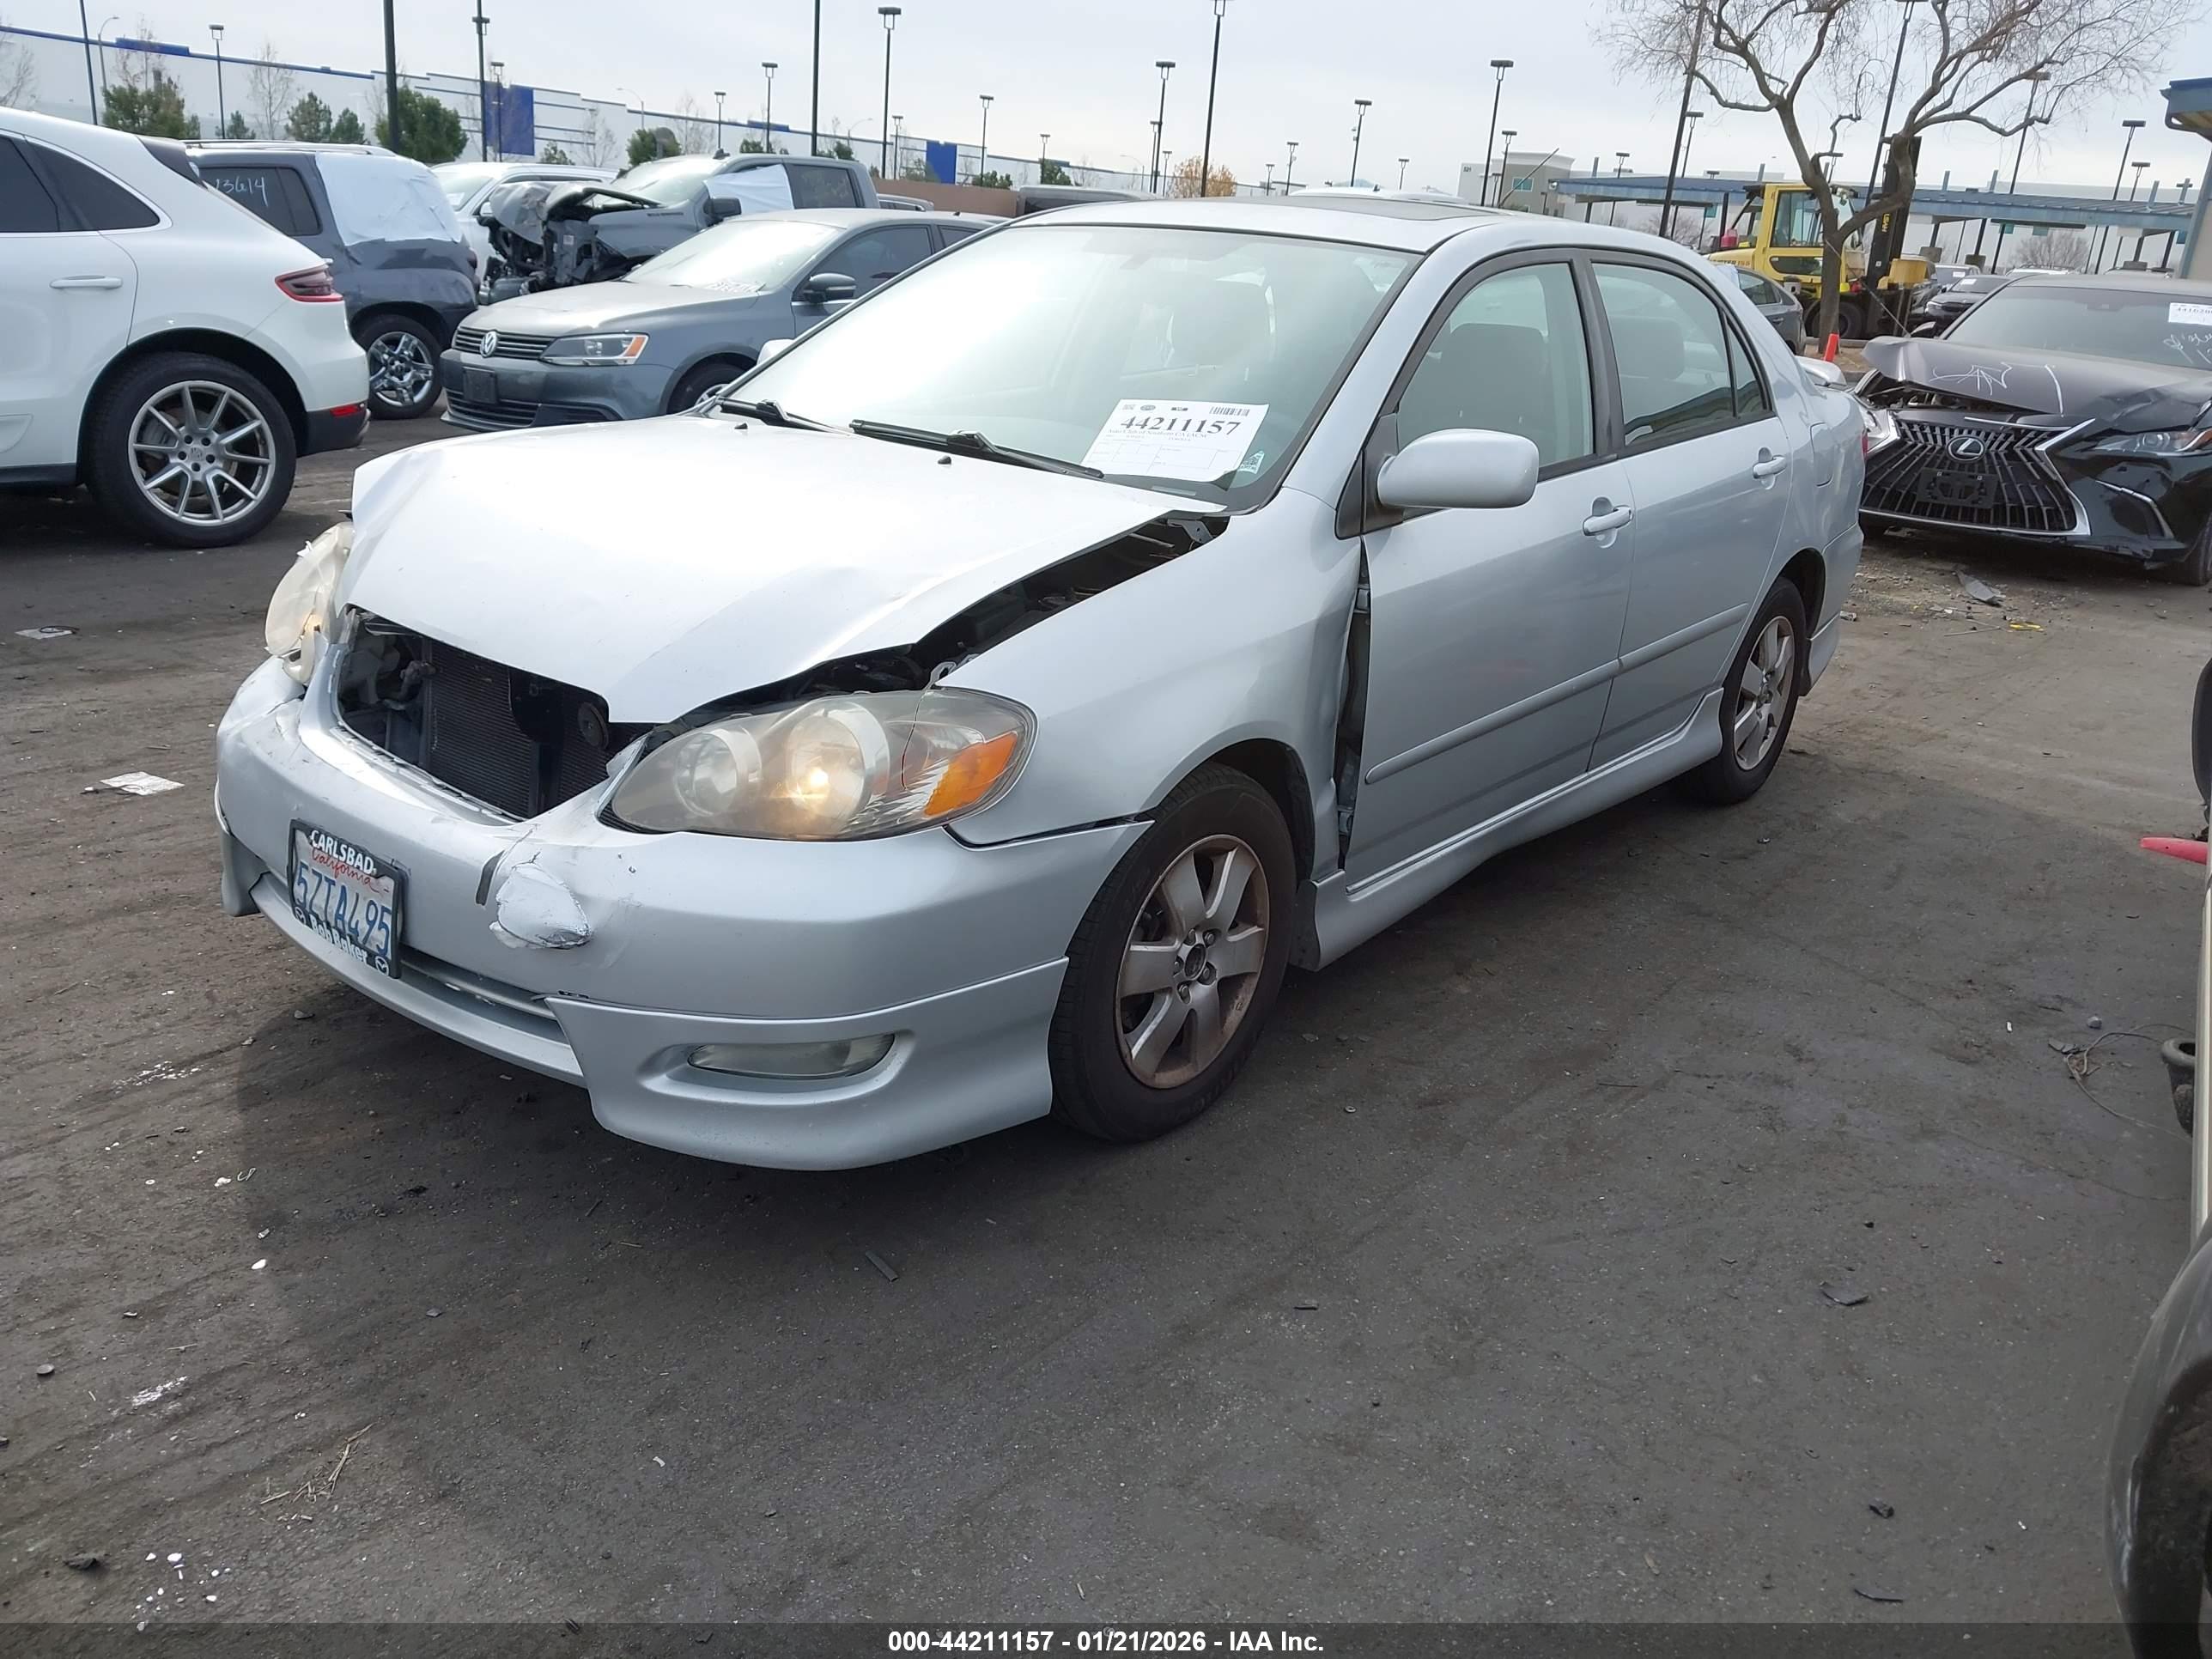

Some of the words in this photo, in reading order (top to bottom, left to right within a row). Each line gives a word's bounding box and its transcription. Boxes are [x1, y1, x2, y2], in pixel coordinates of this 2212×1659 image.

[1120, 416, 1242, 435] 44211157
[309, 830, 374, 874] CARLSBAD
[296, 862, 392, 955] 5ZTA495
[331, 927, 368, 965] Baker
